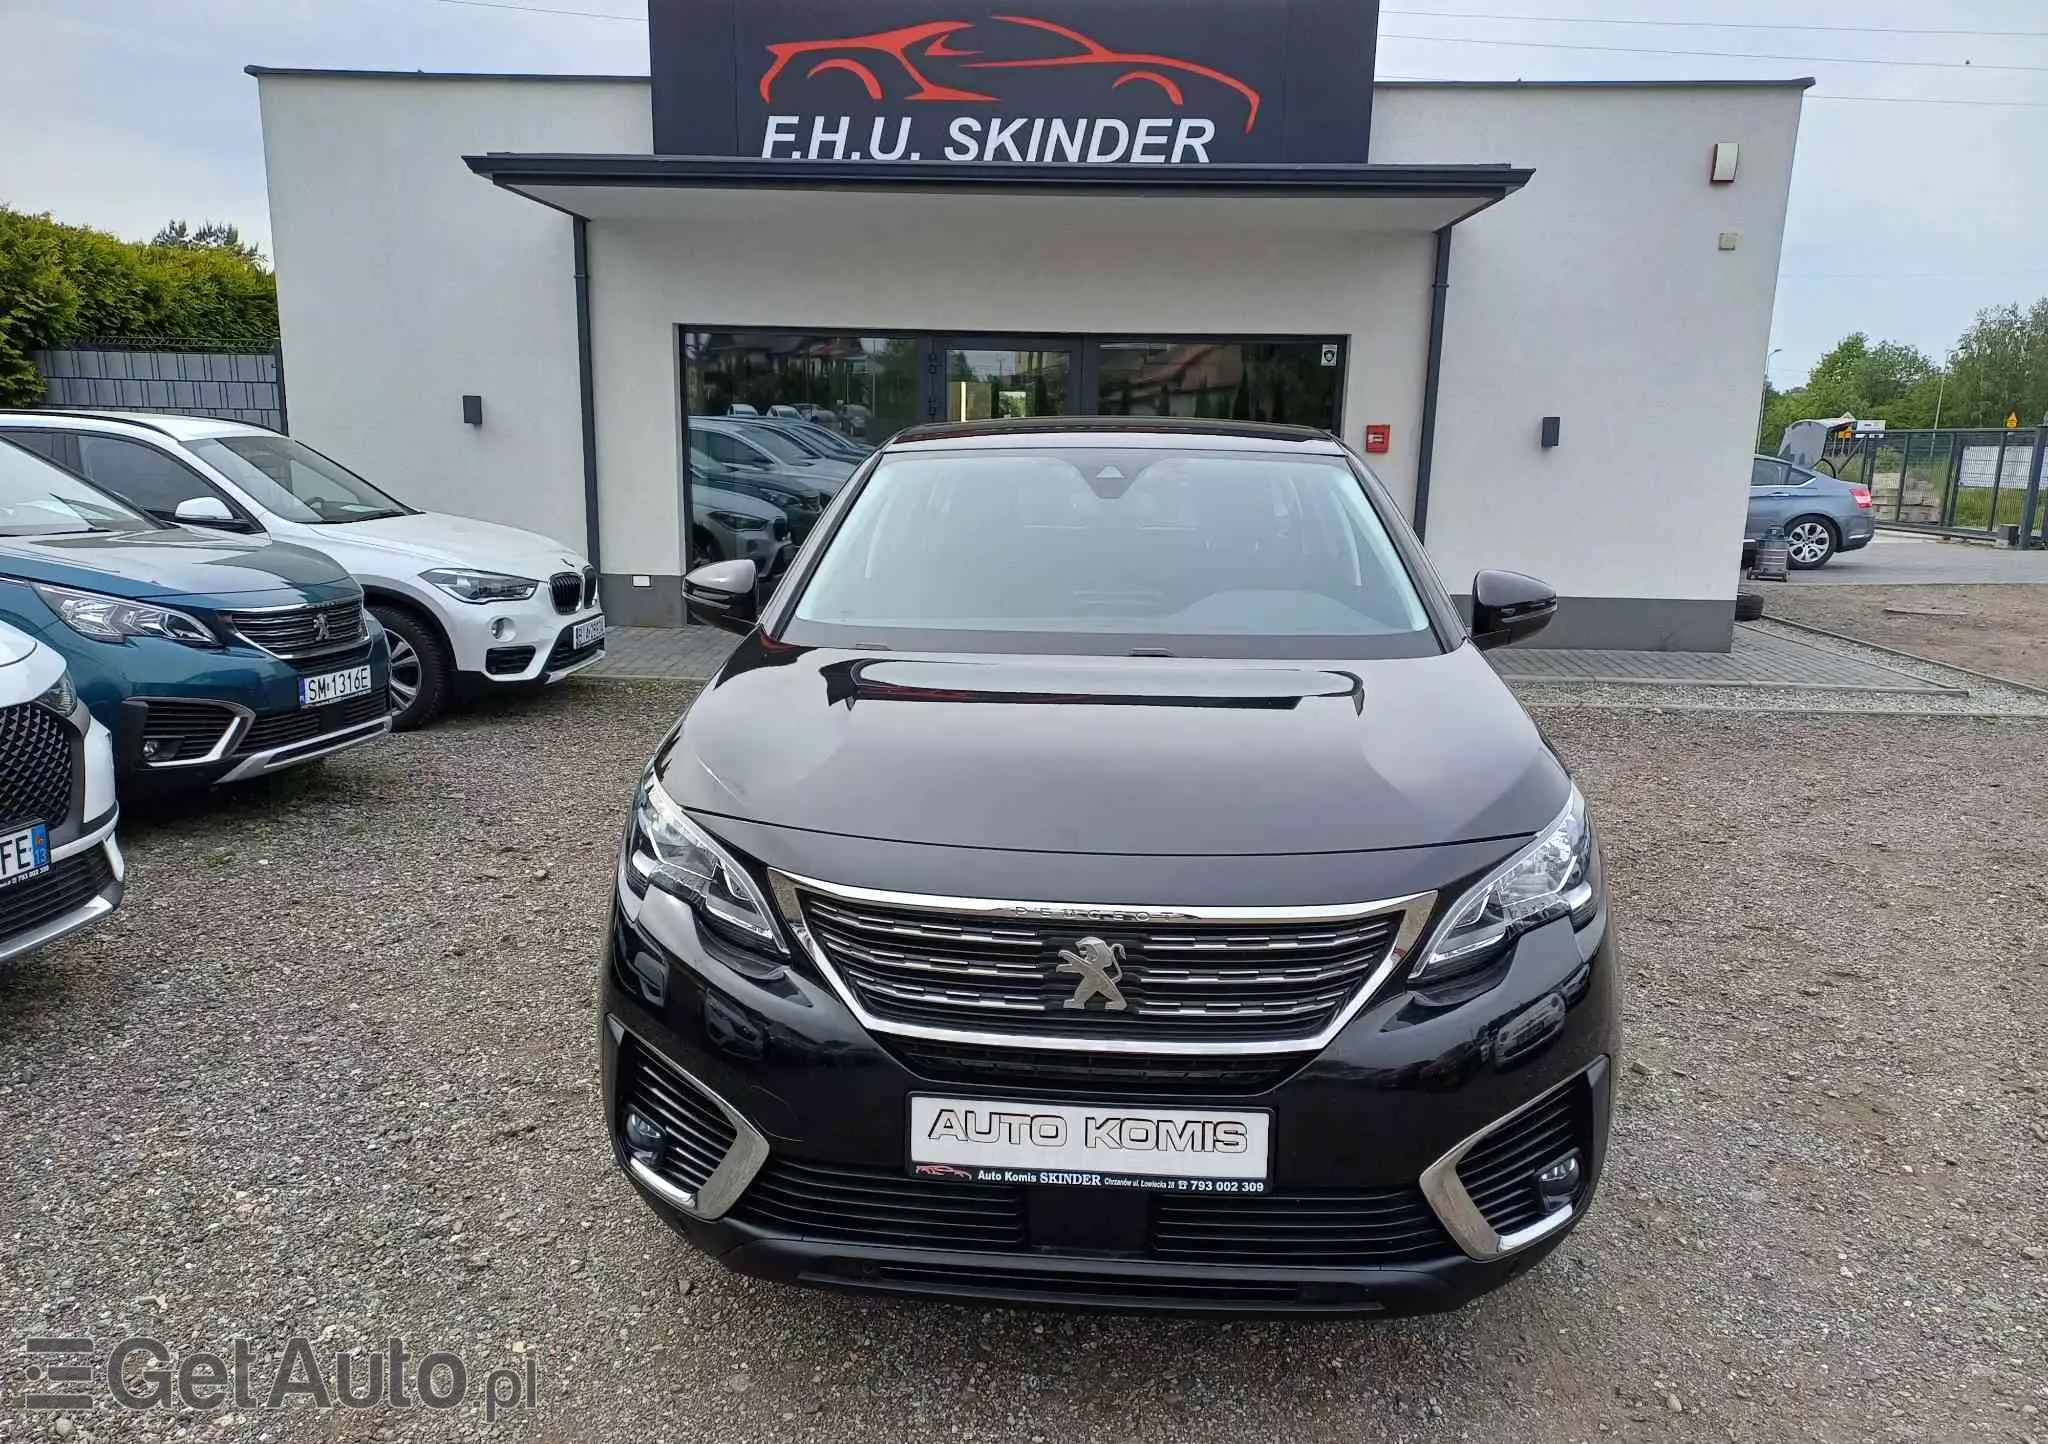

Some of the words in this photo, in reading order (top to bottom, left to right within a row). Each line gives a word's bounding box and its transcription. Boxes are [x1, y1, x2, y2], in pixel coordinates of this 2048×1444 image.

[761, 115, 921, 161] F.H.U.
[944, 117, 1216, 164] SKINDER
[928, 1108, 1068, 1147] AUTO
[1085, 1116, 1248, 1153] KOMIS
[978, 1170, 1002, 1181] Auto
[1004, 1172, 1037, 1183] Komis
[1039, 1172, 1101, 1186] SKINDER
[1191, 1180, 1213, 1192] 793
[1215, 1181, 1238, 1192] 002
[1241, 1182, 1264, 1193] 309
